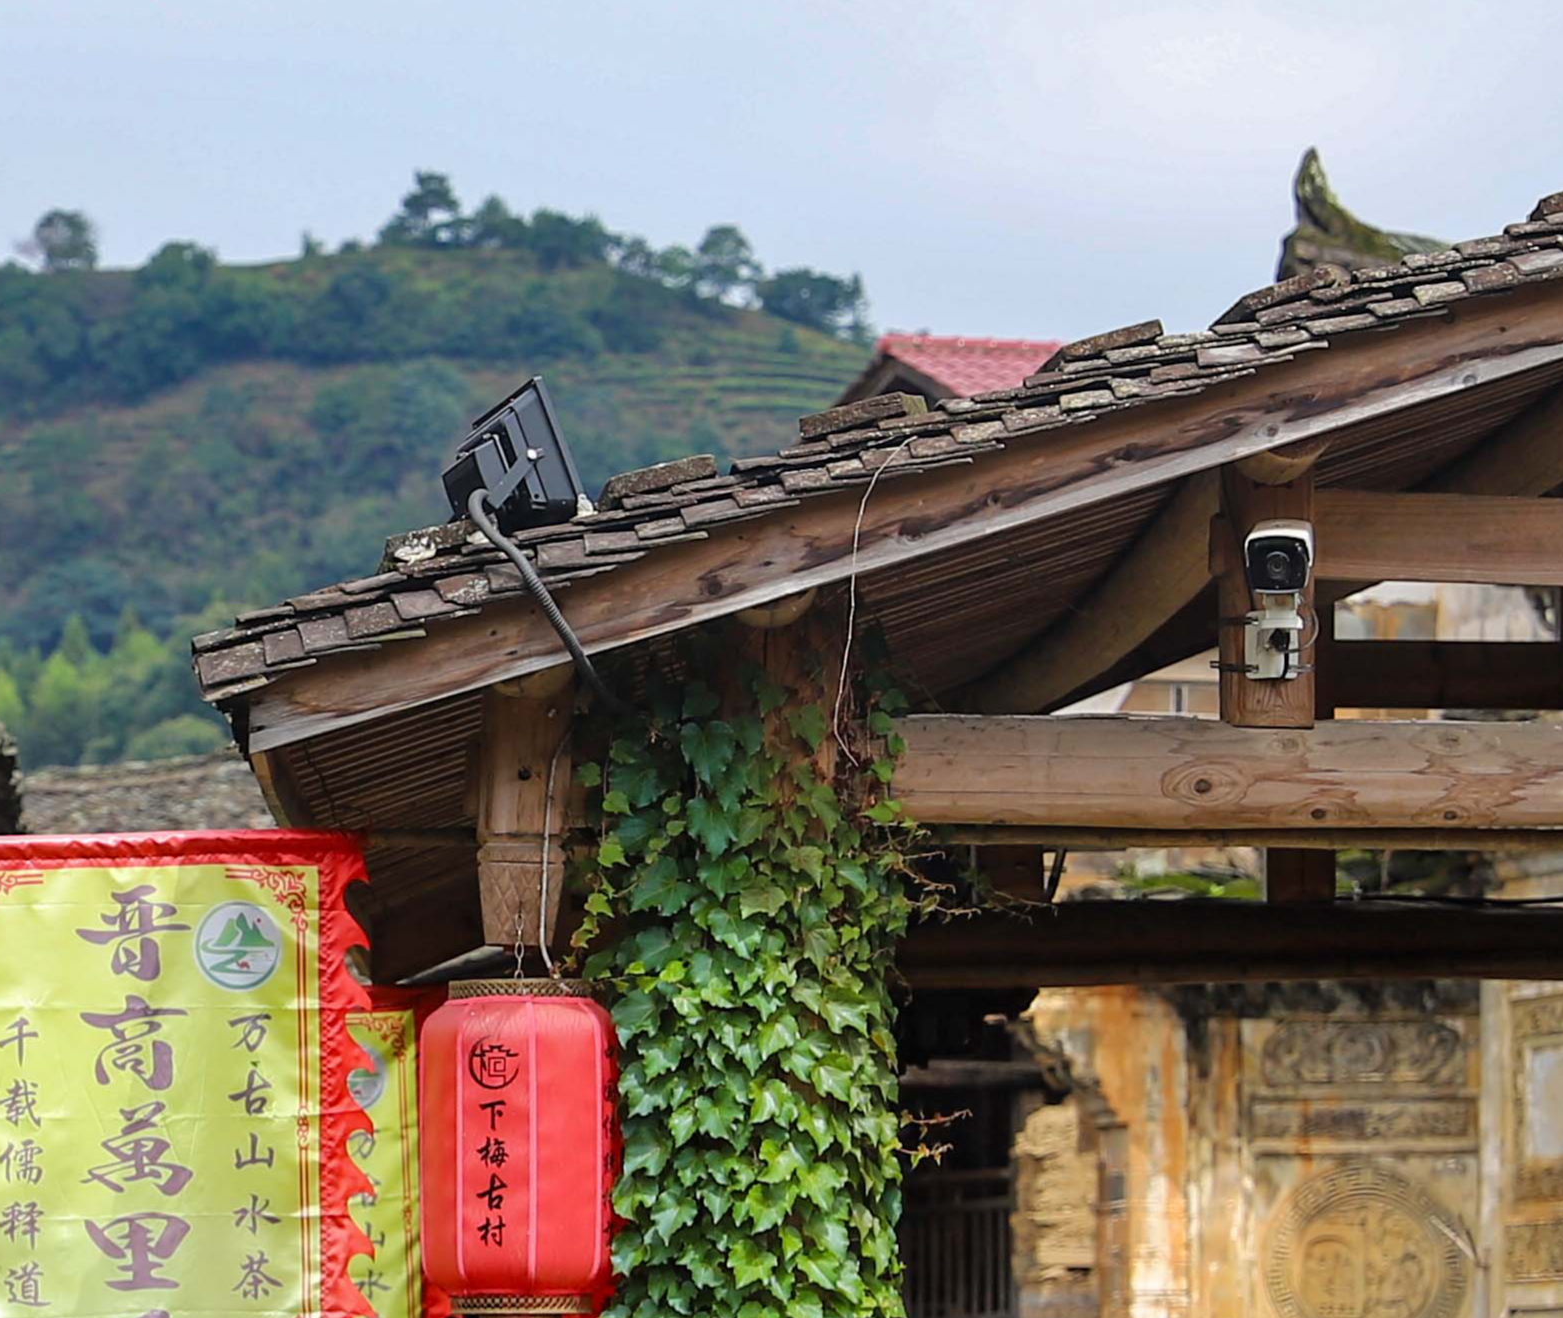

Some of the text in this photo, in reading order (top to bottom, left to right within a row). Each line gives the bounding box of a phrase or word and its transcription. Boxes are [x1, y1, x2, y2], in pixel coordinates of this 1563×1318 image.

[228, 1013, 284, 1301] 万古山水茶
[476, 1099, 510, 1247] 下梅古村
